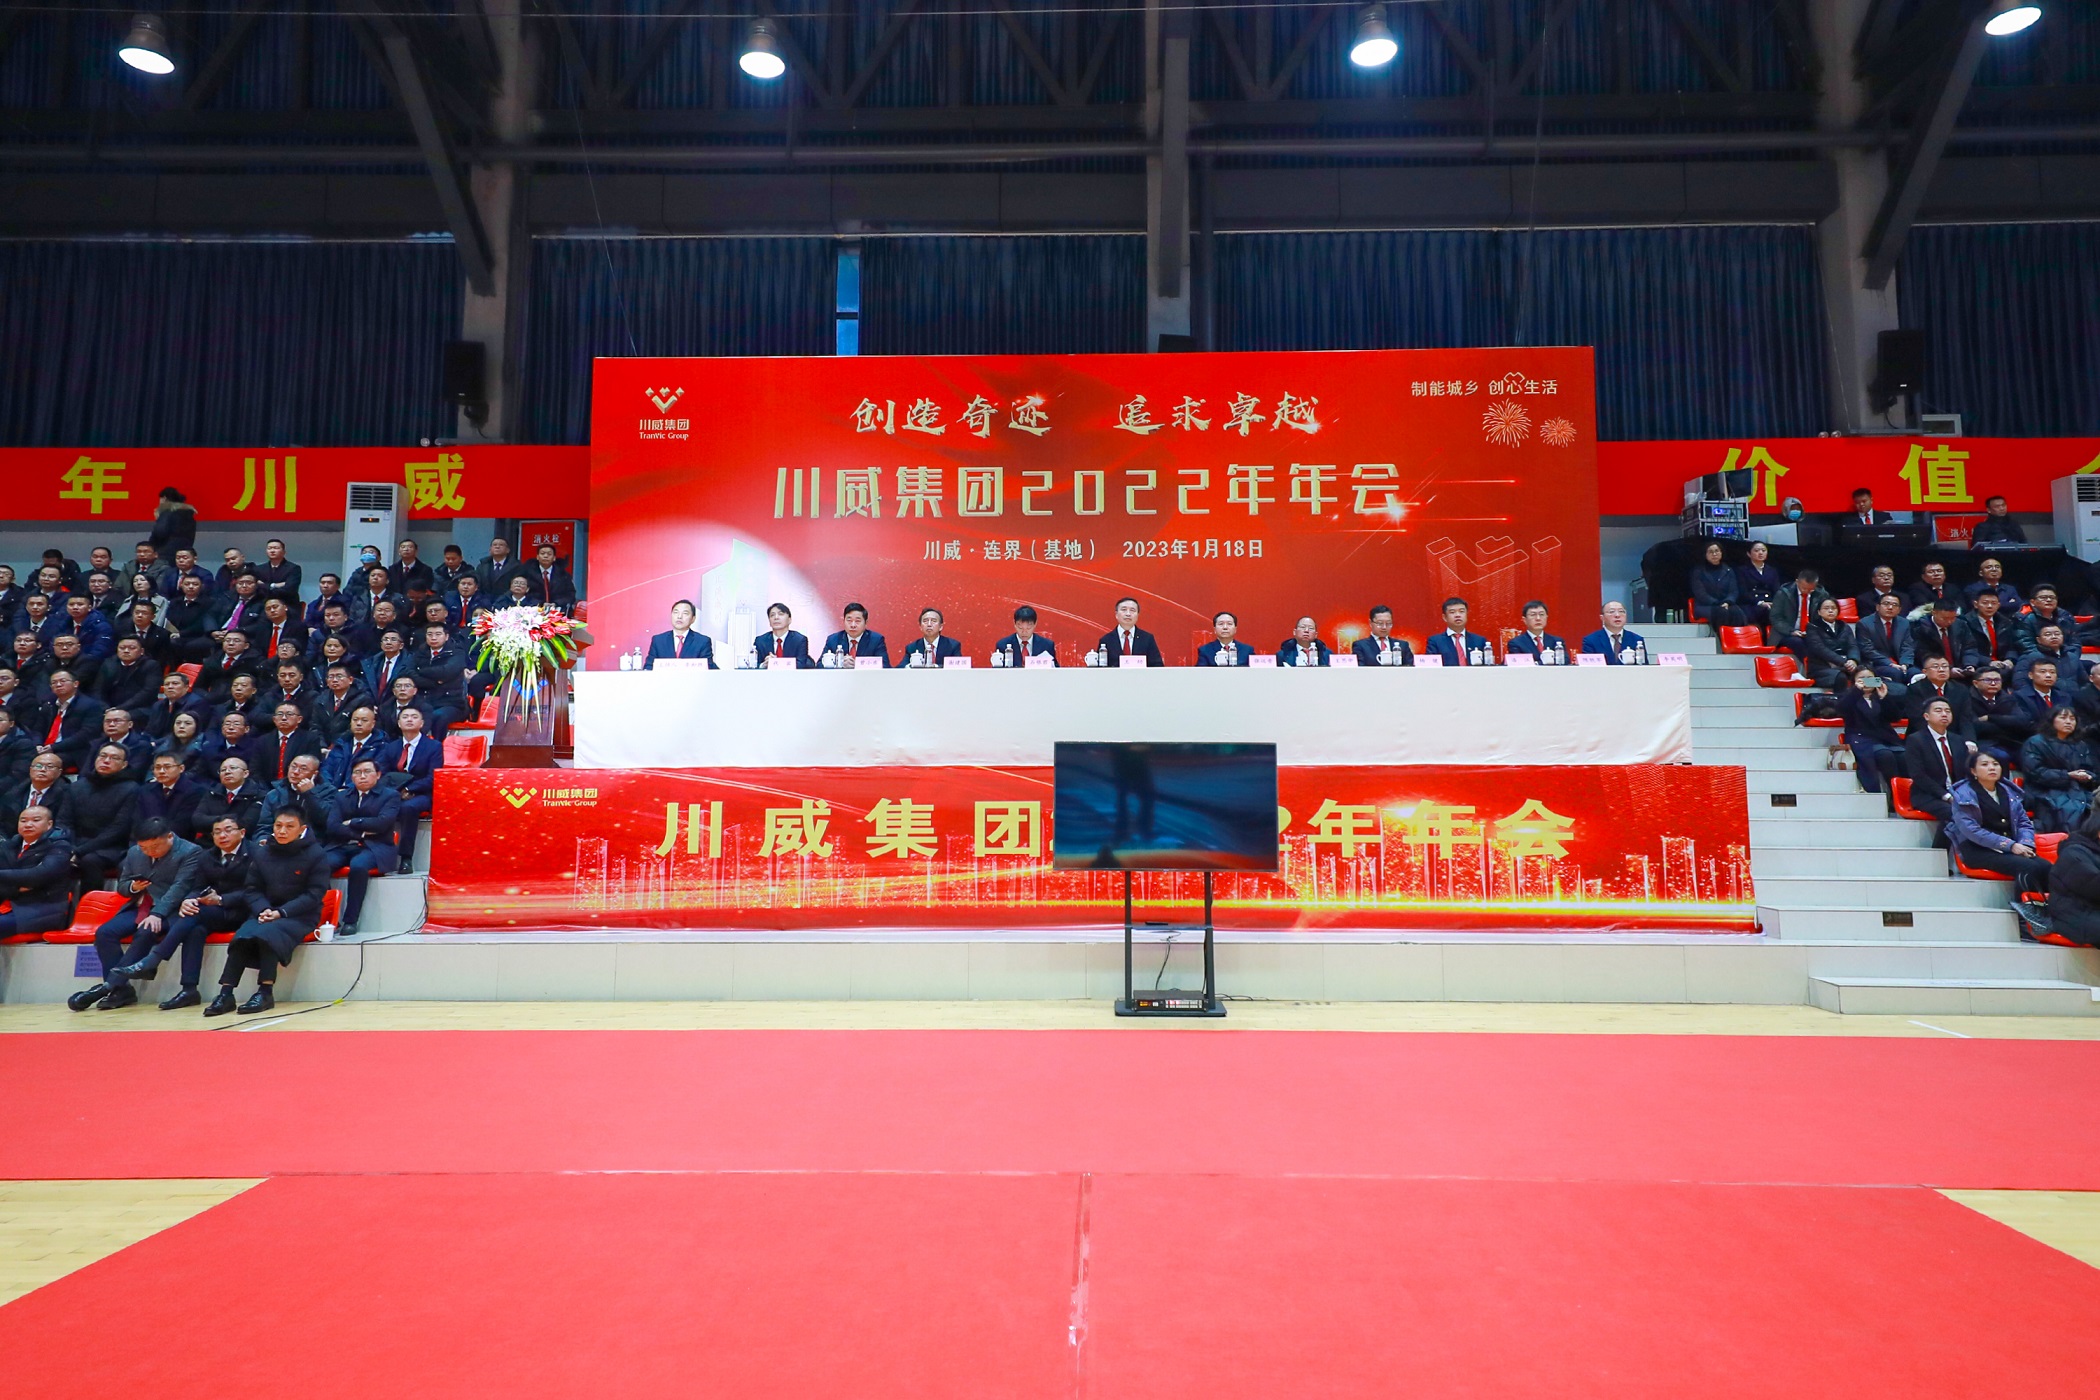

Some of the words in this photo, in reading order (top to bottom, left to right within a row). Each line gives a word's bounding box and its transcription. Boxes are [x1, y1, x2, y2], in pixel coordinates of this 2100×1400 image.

[1411, 381, 1479, 396] 制能城乡
[1488, 378, 1558, 396] 创心生活
[850, 394, 1052, 438] 创造奇迹
[1113, 391, 1321, 436] 追求卓越
[639, 418, 690, 431] 川威集团
[667, 431, 690, 441] Group
[773, 462, 1401, 519] 川威集团2022年年会
[1122, 538, 1263, 560] 2023年1月18日
[542, 788, 598, 799] 川威集团
[574, 799, 598, 808] Group
